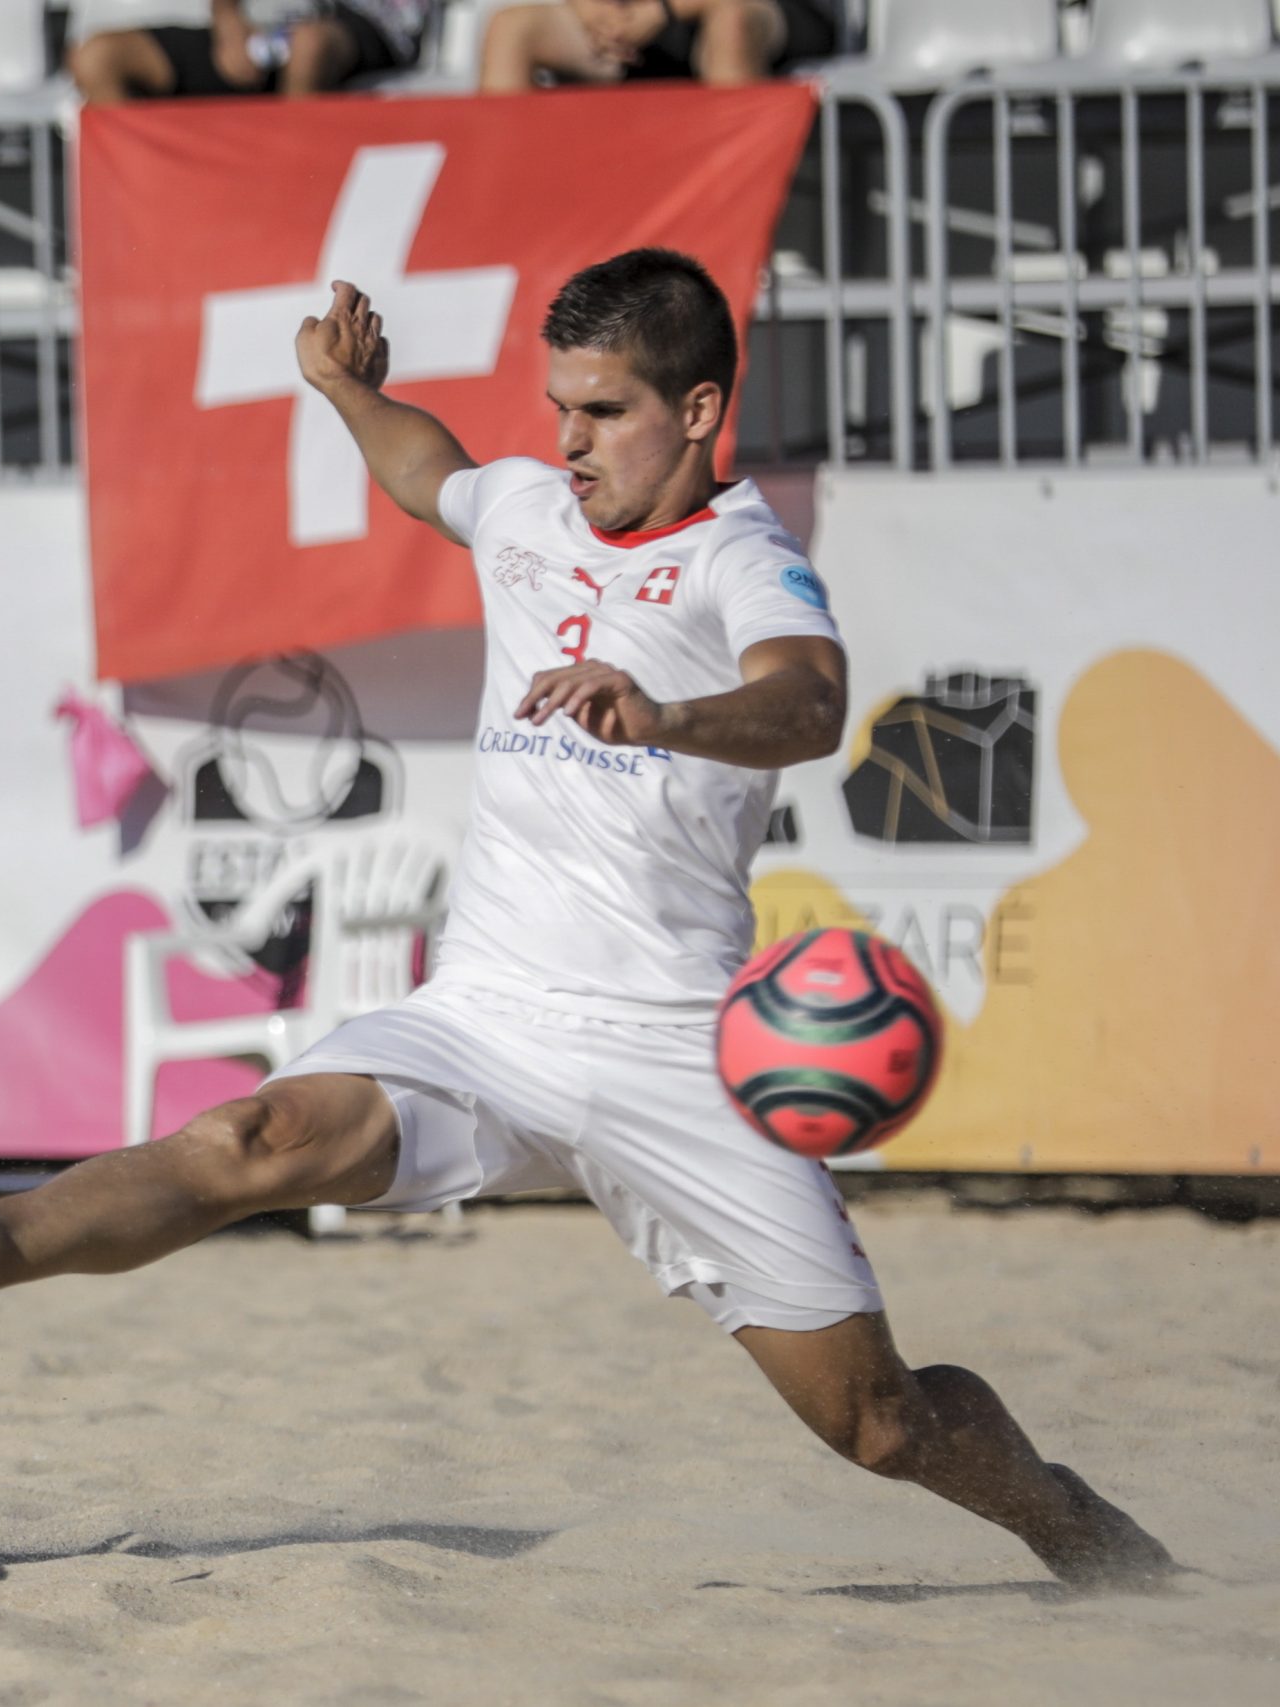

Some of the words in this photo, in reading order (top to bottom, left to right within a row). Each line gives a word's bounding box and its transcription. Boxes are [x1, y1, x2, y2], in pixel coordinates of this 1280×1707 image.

[556, 613, 592, 663] 3
[479, 727, 552, 756] CREDIT
[556, 734, 646, 777] SUISSE
[752, 884, 1037, 984] ARÉ
